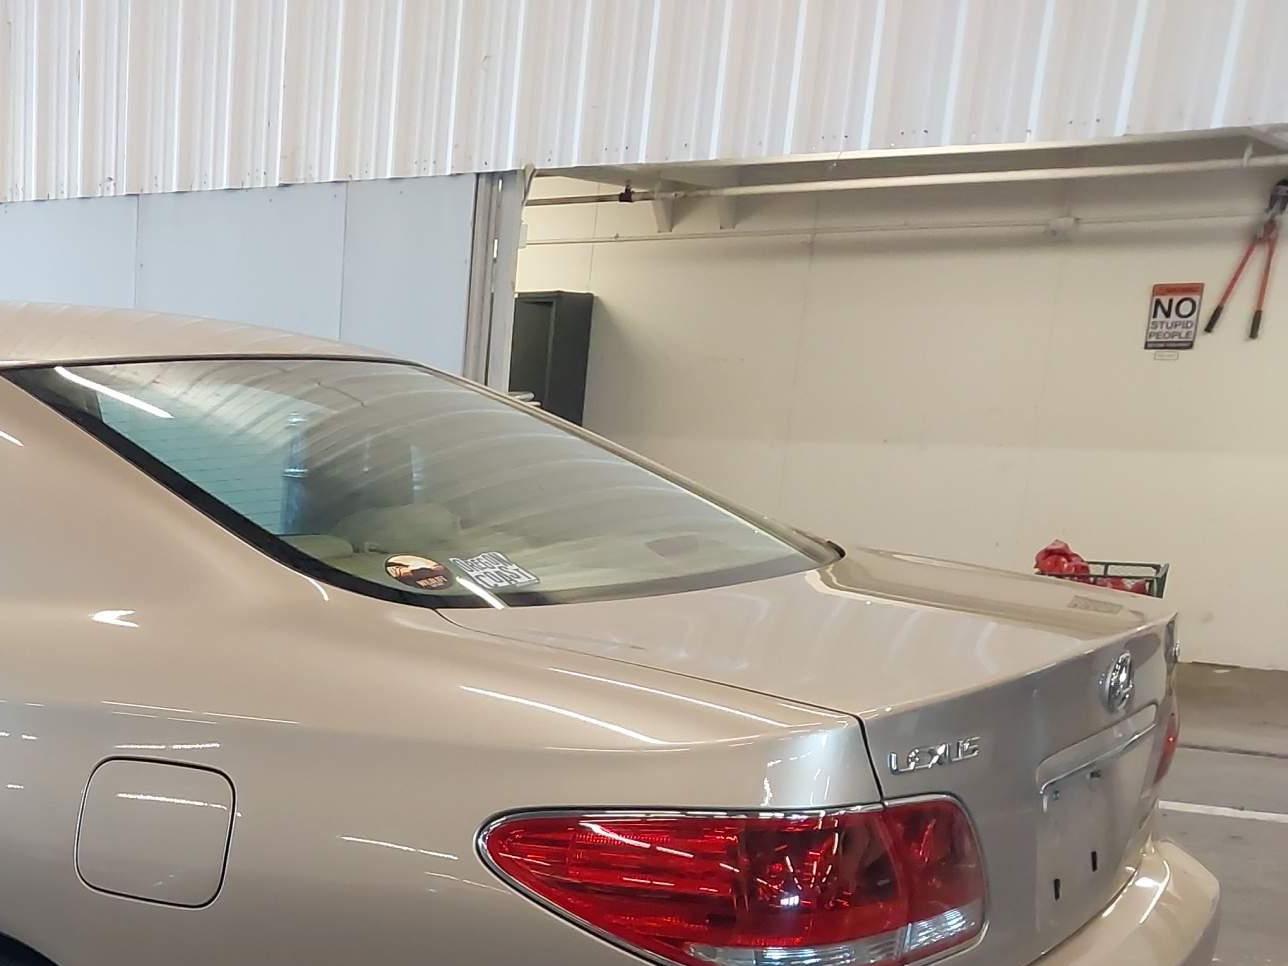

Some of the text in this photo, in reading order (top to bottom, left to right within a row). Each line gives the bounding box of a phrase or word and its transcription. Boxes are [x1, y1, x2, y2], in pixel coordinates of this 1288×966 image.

[1152, 297, 1197, 319] NO
[1148, 330, 1193, 340] PEOPLE
[1151, 320, 1194, 330] STUPID
[475, 566, 533, 587] COAST
[890, 737, 980, 775] LEXUS
